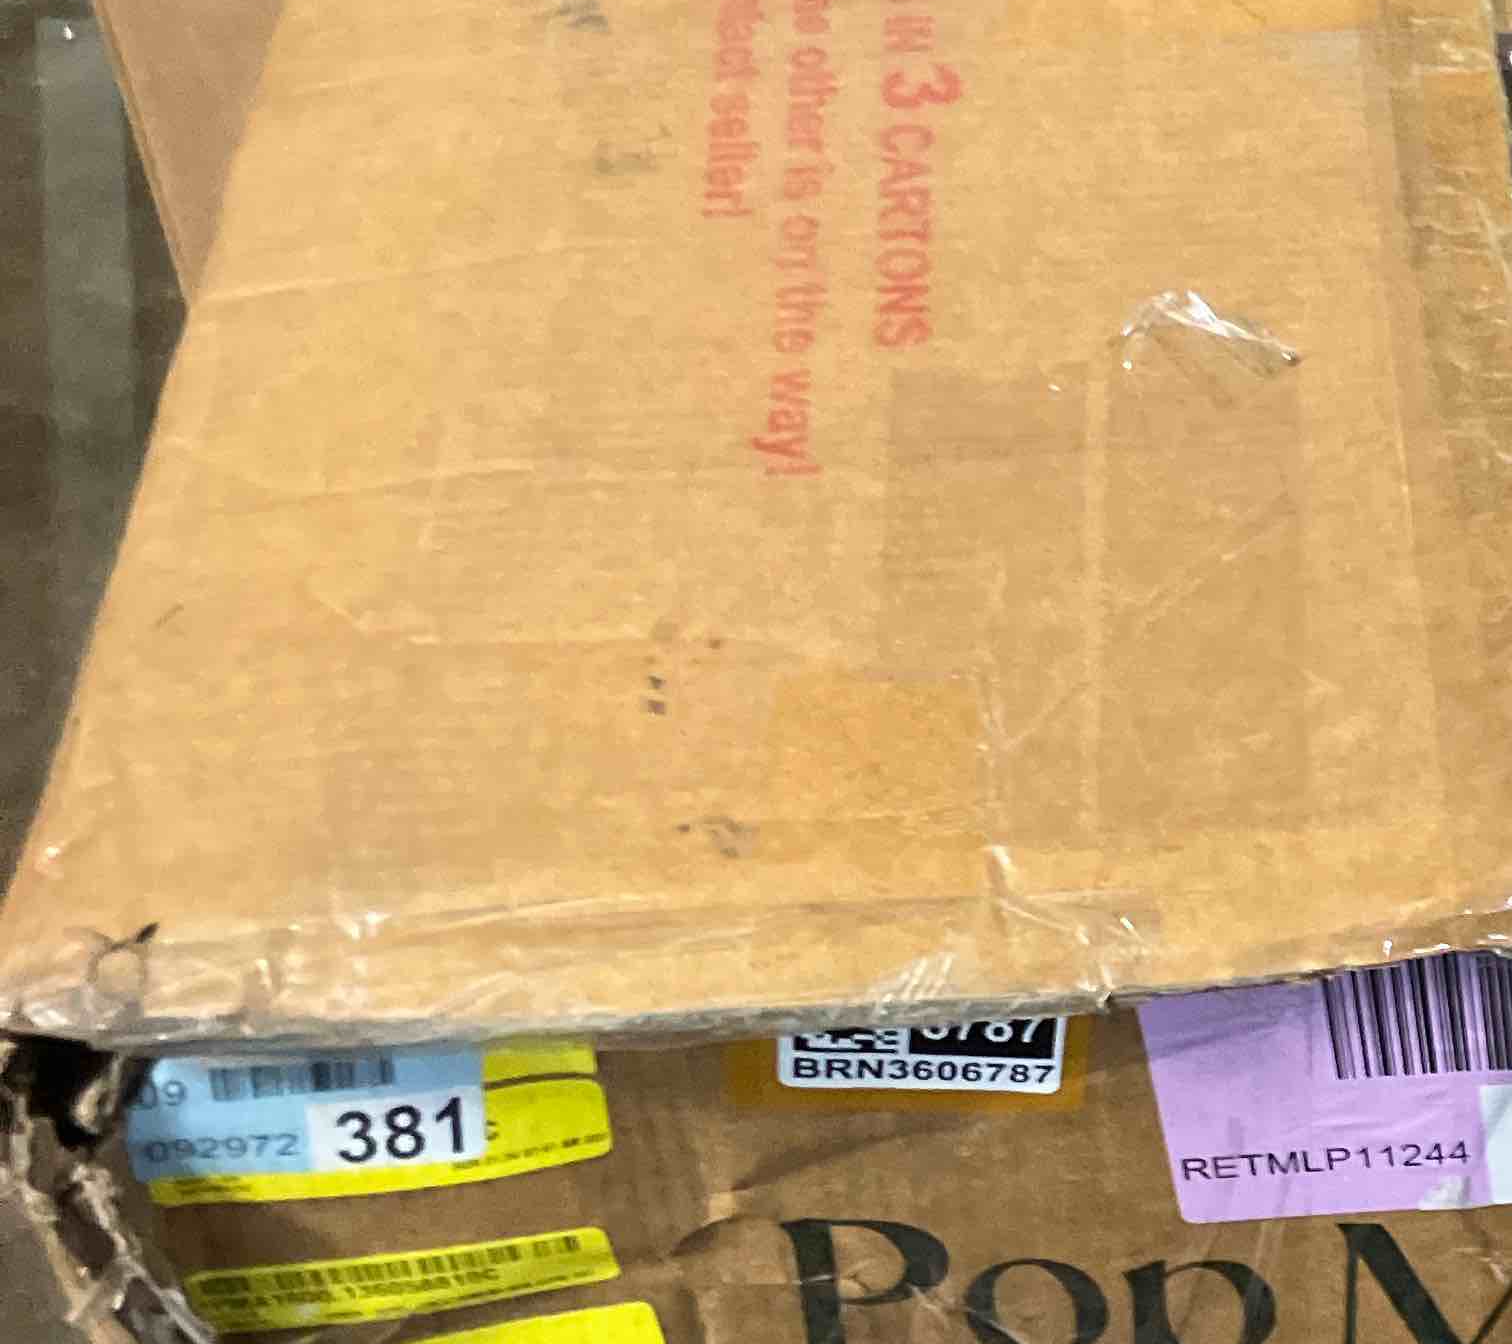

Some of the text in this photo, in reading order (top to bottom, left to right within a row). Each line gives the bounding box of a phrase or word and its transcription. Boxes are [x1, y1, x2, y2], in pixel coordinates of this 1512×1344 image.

[883, 16, 935, 54] IN
[786, 46, 839, 153] other
[883, 63, 964, 112] 3
[700, 91, 762, 219] seller!
[781, 164, 836, 202] is
[873, 125, 934, 350] CARTONS
[773, 280, 828, 355] the
[752, 370, 822, 478] way!
[793, 1057, 1055, 1084] BRN3606787
[336, 1097, 466, 1164] 381
[1180, 1140, 1471, 1183] RETMLP11244
